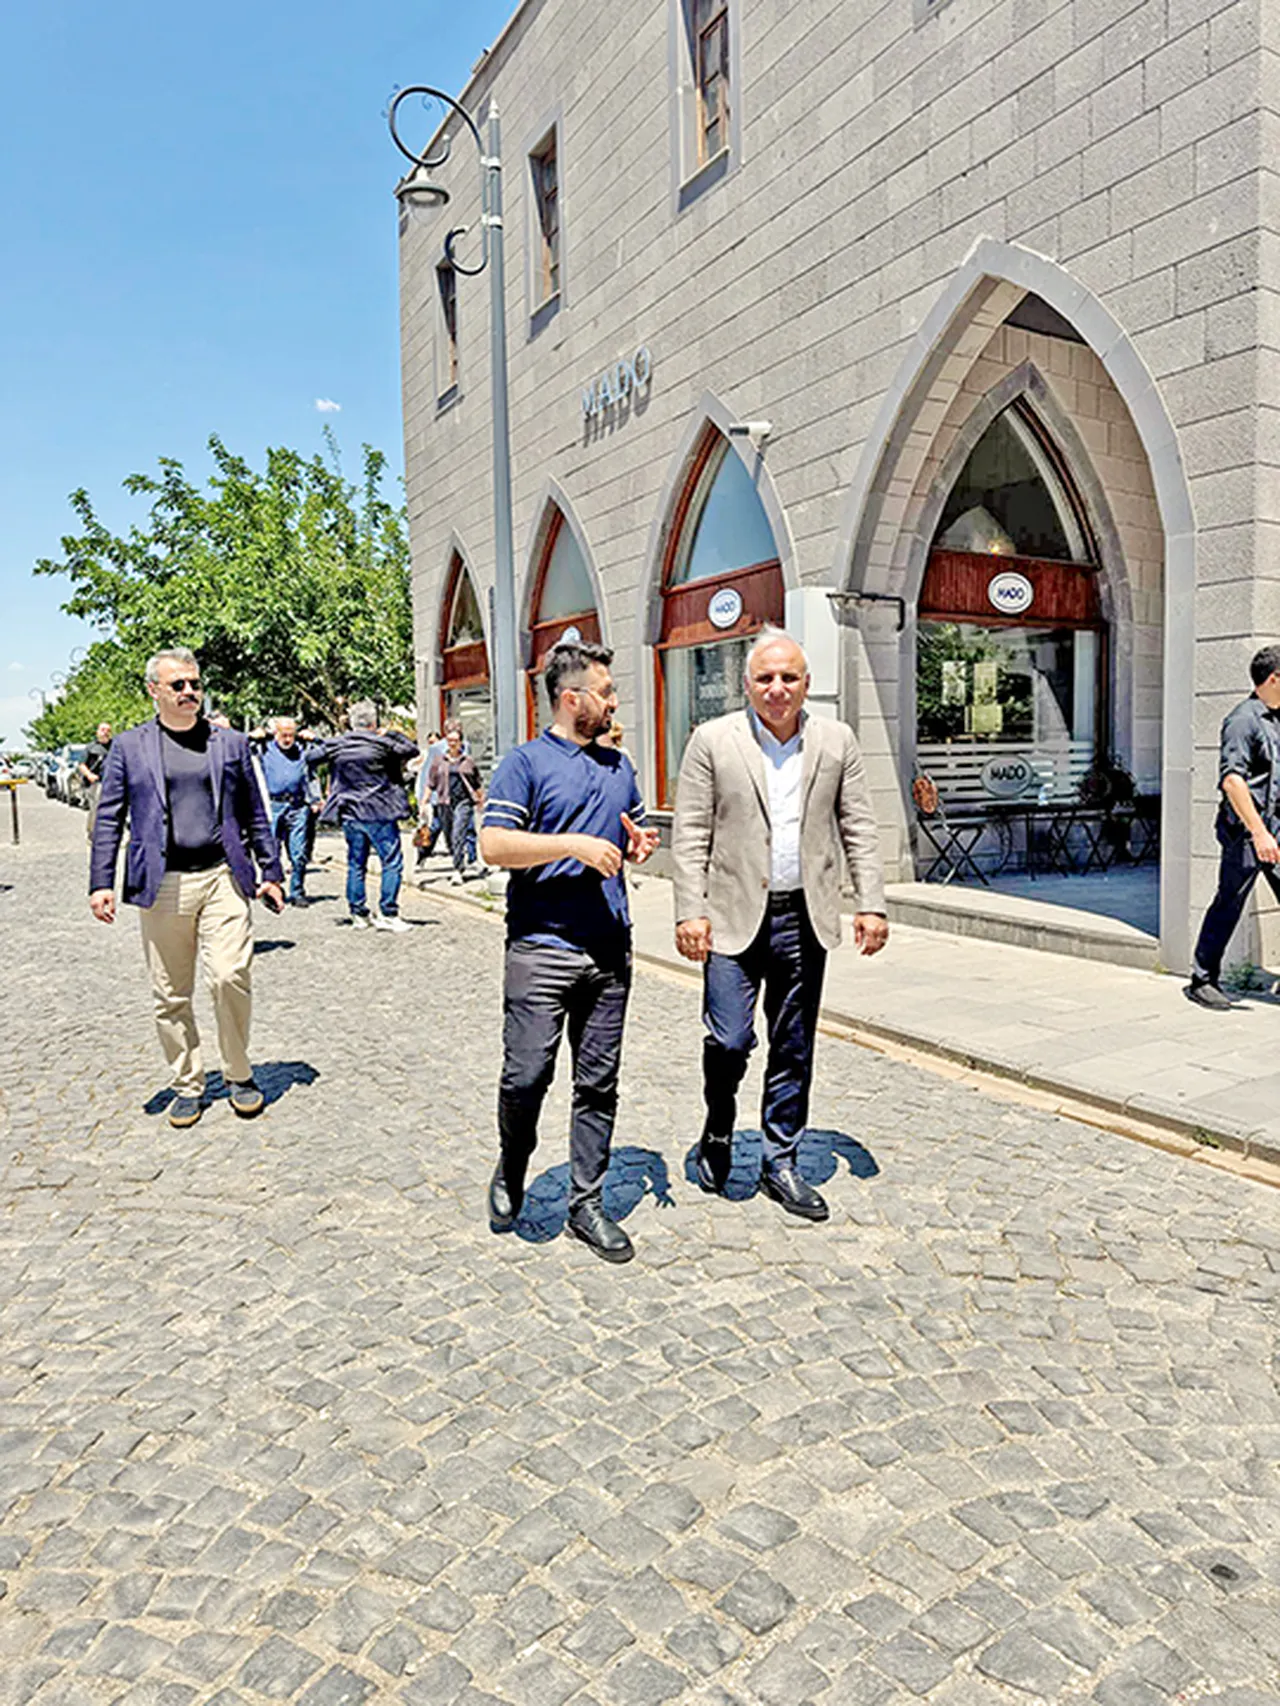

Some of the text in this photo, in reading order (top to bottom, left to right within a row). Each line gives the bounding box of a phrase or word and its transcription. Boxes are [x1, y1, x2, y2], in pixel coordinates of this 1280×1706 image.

[582, 345, 650, 414] MADO
[998, 587, 1025, 600] MADO
[990, 764, 1027, 780] MADO
